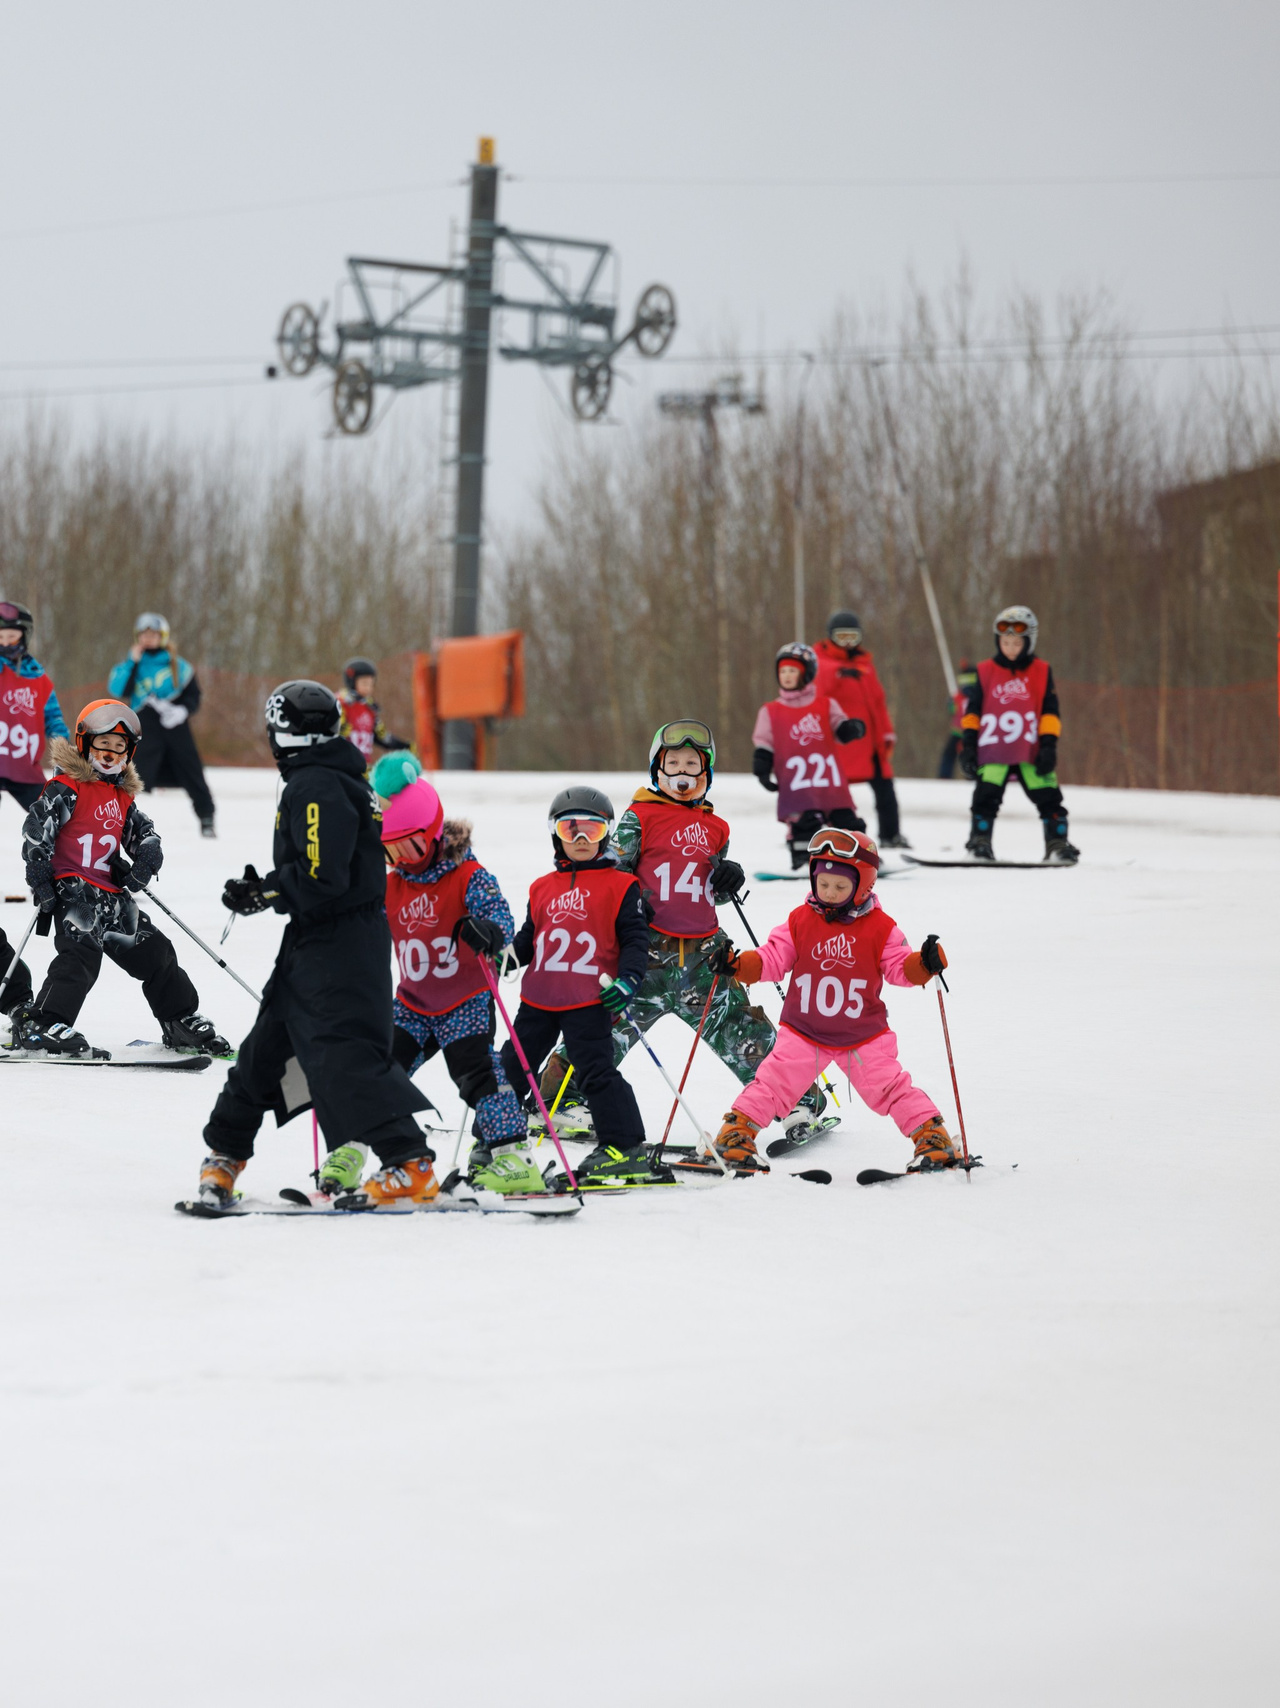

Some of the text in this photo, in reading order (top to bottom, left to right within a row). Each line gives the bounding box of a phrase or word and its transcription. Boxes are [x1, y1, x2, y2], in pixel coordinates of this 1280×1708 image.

[978, 710, 1038, 747] 293
[786, 752, 841, 791] 221
[77, 833, 117, 872] 12
[306, 803, 320, 879] HEAD
[534, 928, 599, 976] 122
[795, 973, 868, 1019] 105
